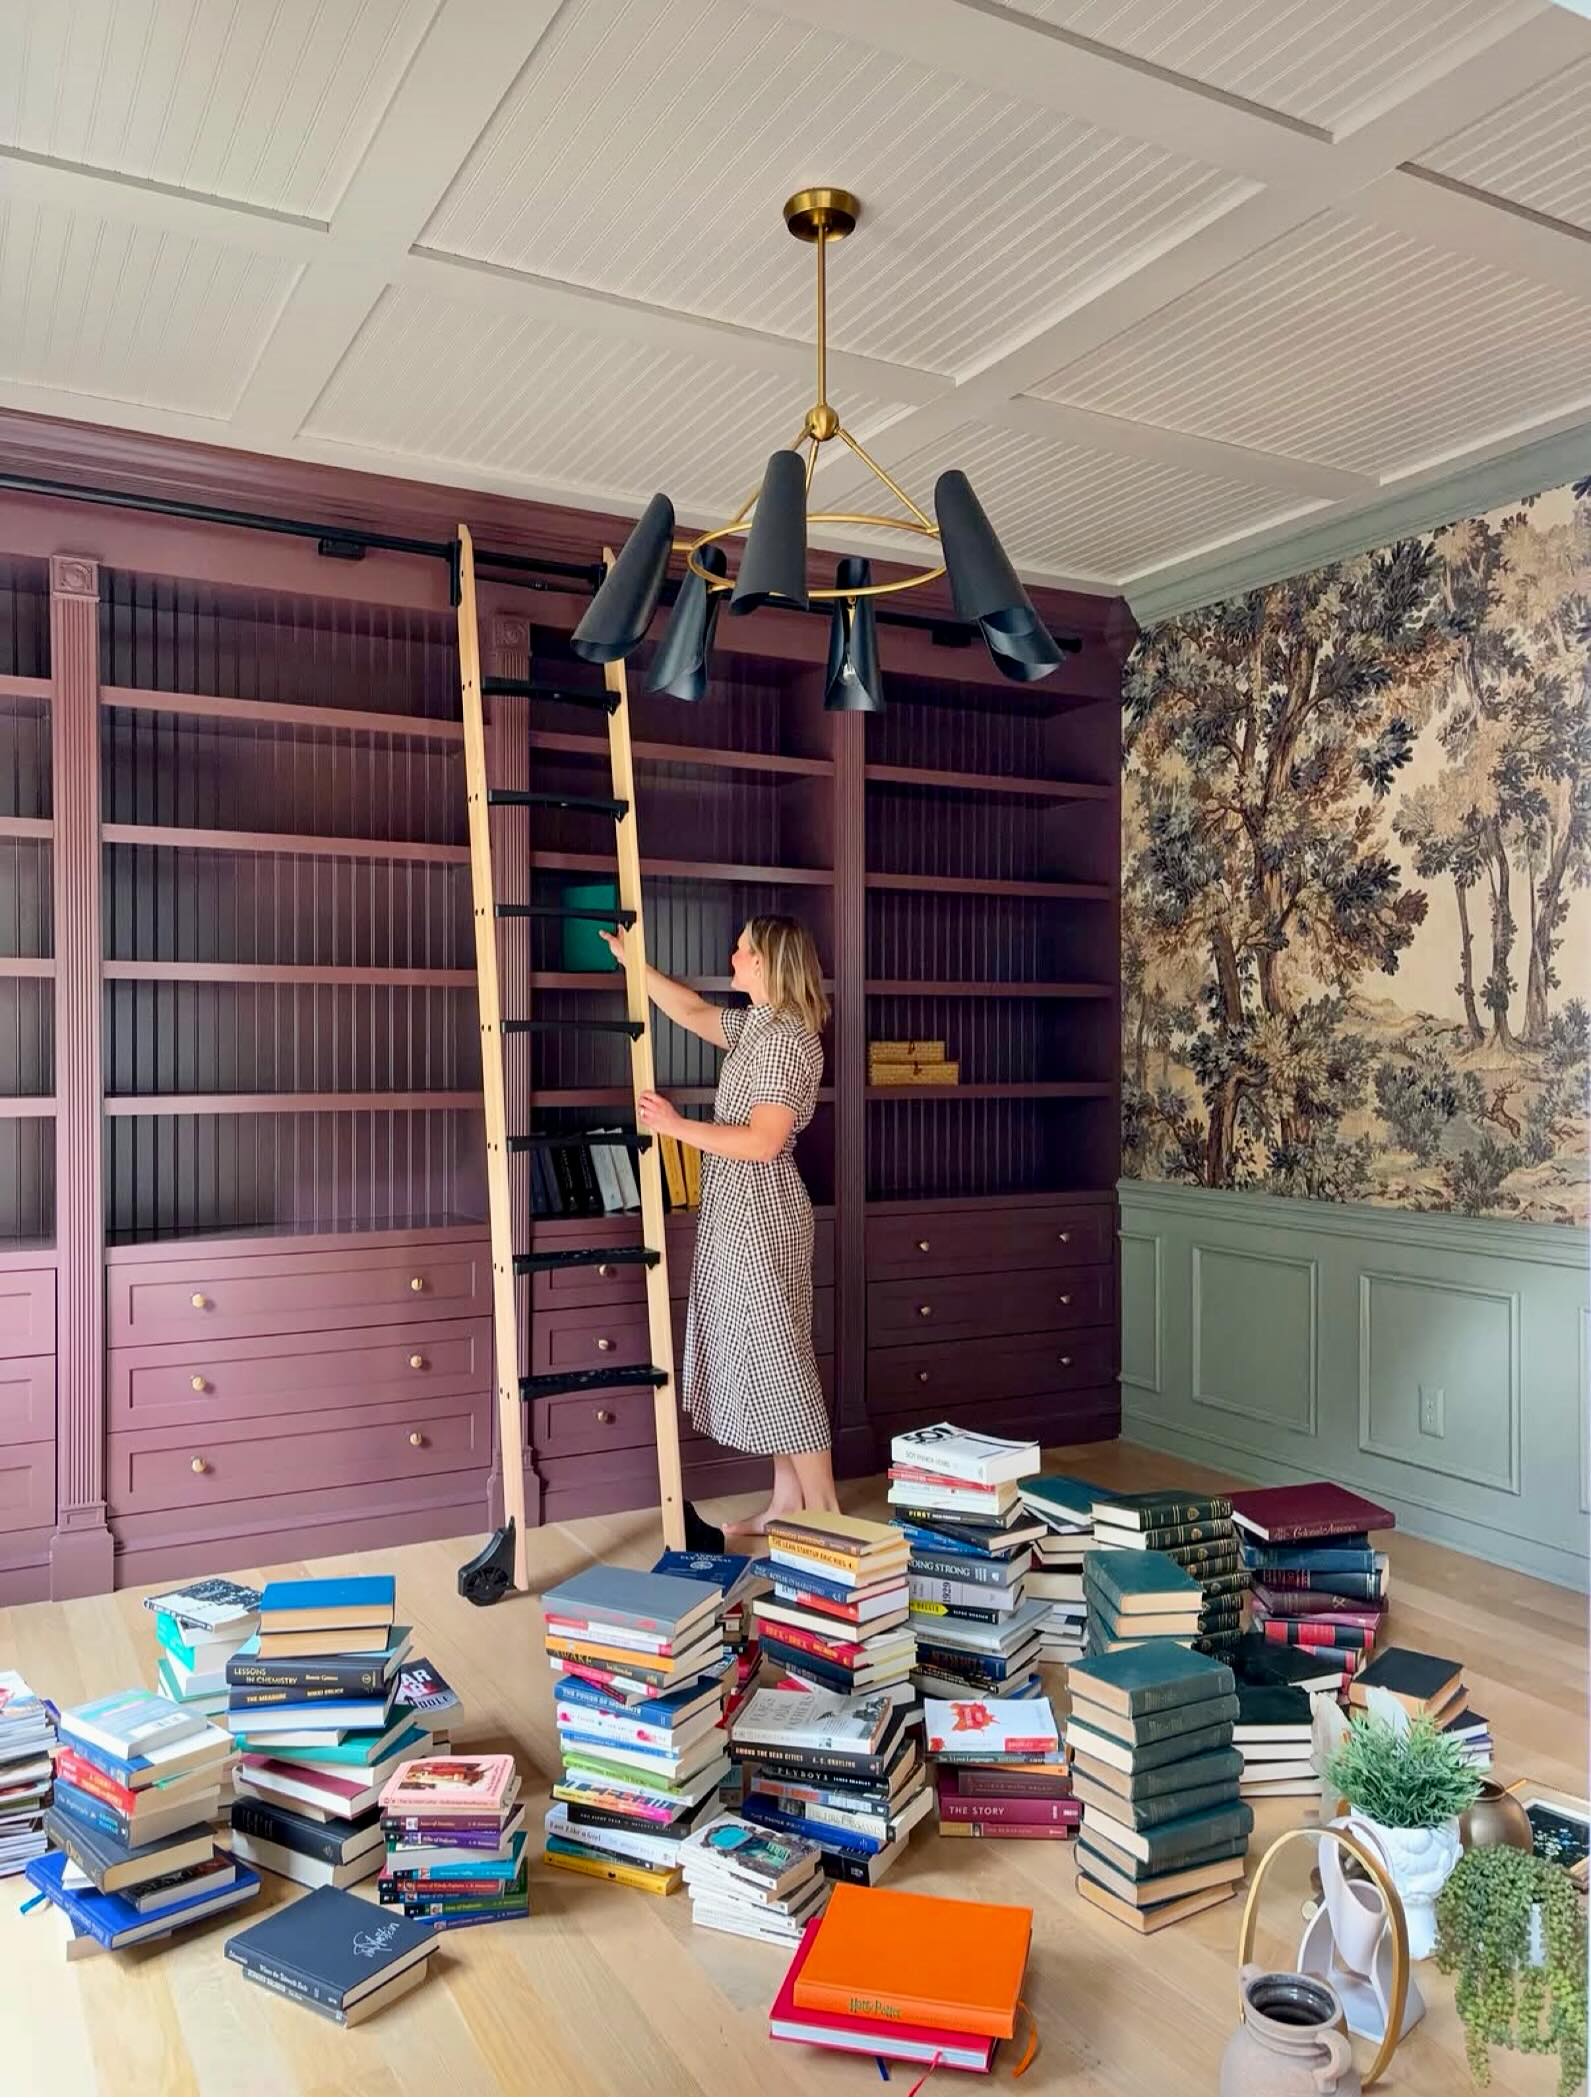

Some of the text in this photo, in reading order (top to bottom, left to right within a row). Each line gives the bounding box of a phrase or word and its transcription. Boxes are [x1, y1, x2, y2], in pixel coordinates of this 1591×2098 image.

[908, 1559, 970, 1577] DING STRONG
[234, 1667, 266, 1676] LESSONS
[256, 1676, 298, 1684] CHEMISTRY
[757, 1749, 768, 1757] THE
[777, 1767, 828, 1781] FLYBOYS
[949, 1806, 1005, 1816] THE STORY
[565, 1824, 580, 1835] Like
[849, 1997, 901, 2018] Harry Potter
